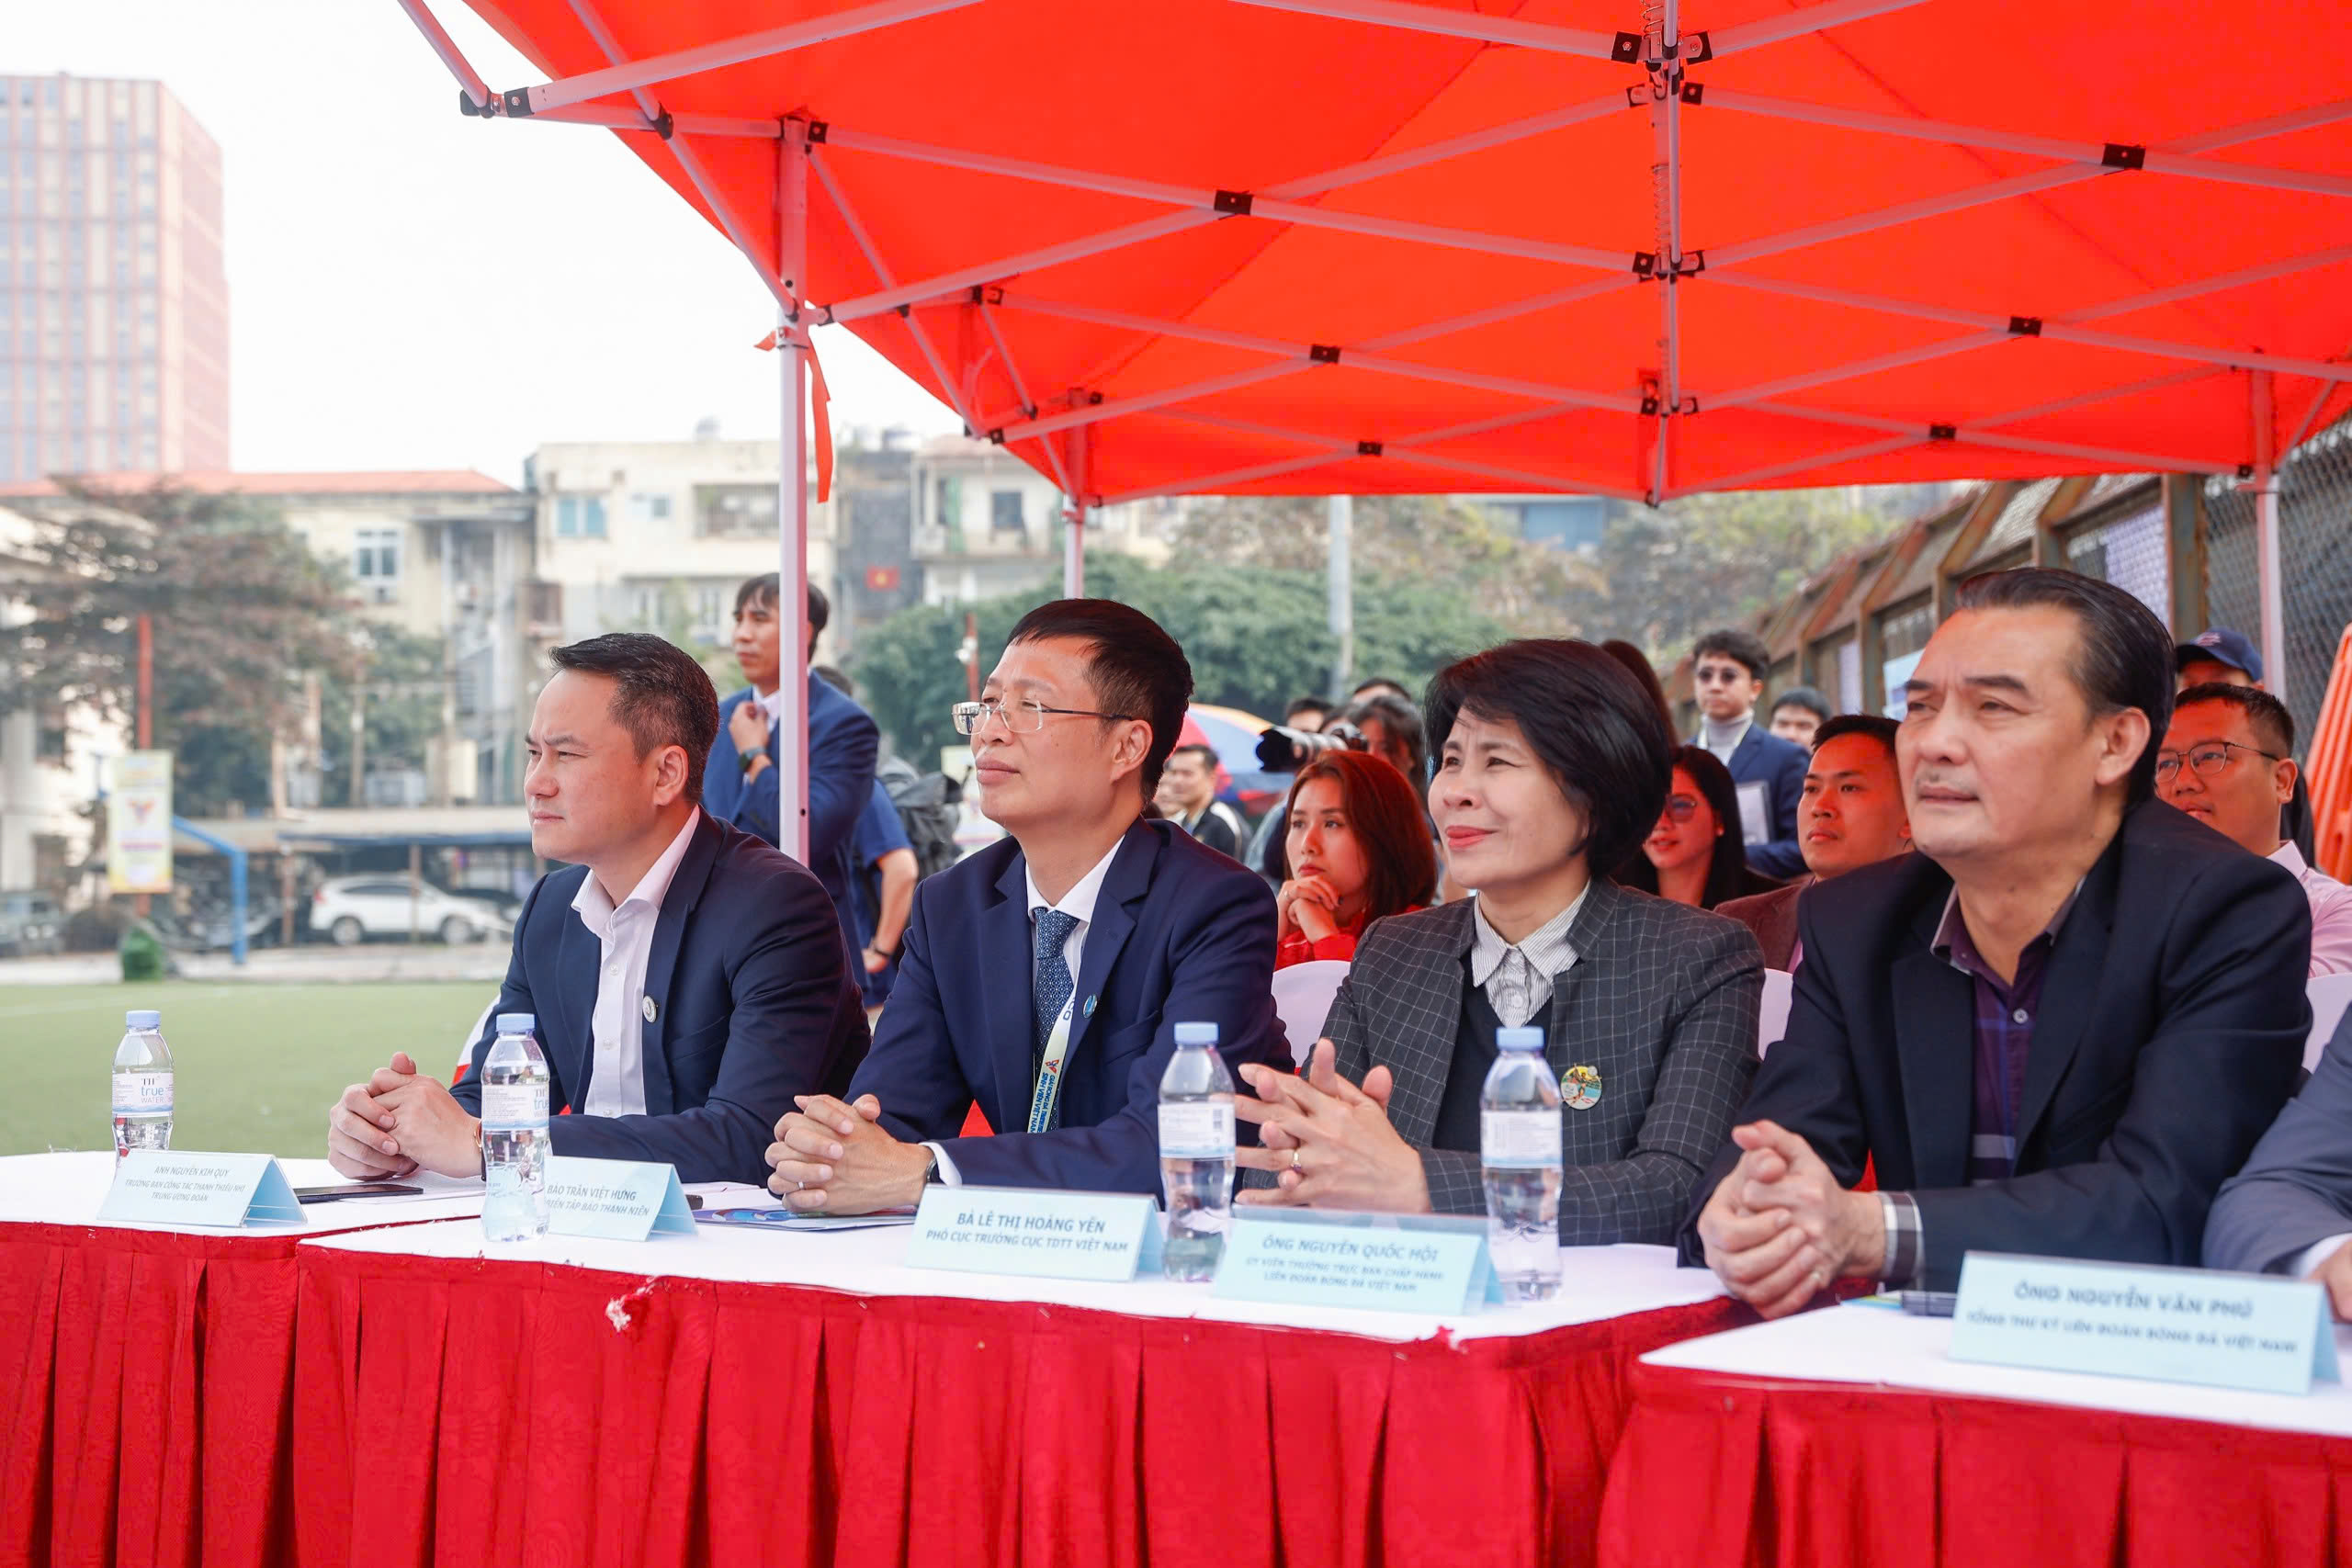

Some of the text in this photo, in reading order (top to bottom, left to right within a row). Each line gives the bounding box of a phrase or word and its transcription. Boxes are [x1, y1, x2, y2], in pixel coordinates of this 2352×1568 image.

[1040, 1072, 1049, 1088] SINH
[141, 1086, 164, 1097] true
[198, 1168, 213, 1177] KIM
[611, 1189, 638, 1201] HƯNG
[600, 1203, 628, 1214] THANH
[628, 1205, 650, 1216] NIÊN
[978, 1210, 993, 1227] LÊ
[998, 1214, 1021, 1230] THỊ
[1046, 1238, 1072, 1249] TDTT
[1076, 1238, 1099, 1252] VIỆT
[1103, 1241, 1129, 1253] NAM
[1262, 1235, 1294, 1250] ÔNG
[2013, 1279, 2061, 1302] ÔNG
